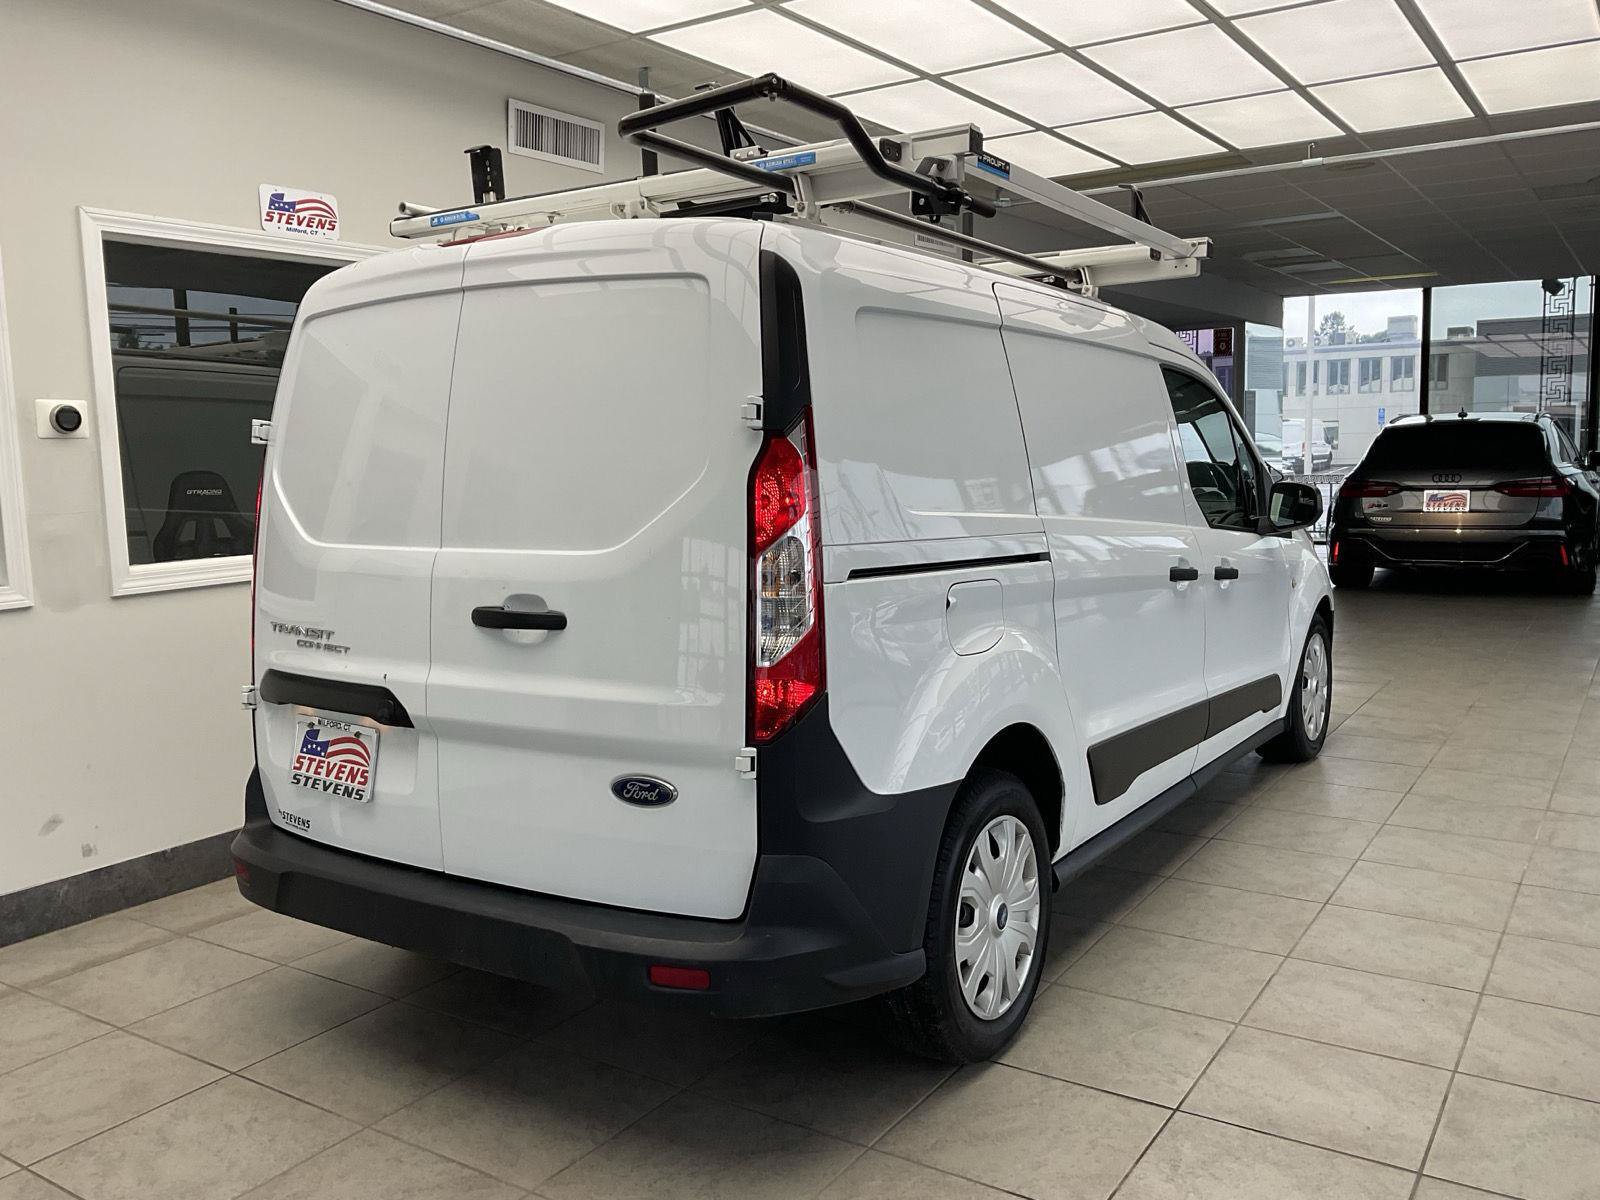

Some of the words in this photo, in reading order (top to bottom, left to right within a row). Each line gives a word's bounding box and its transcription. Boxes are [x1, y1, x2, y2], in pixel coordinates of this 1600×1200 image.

[264, 211, 337, 231] STEVENS
[286, 226, 308, 237] Milford,
[270, 621, 335, 640] TRANSIT
[296, 639, 351, 654] CONNECT
[292, 754, 369, 786] STEVENS
[291, 773, 366, 801] STEVENS
[623, 781, 659, 800] Ford
[281, 810, 311, 829] STEVENS
